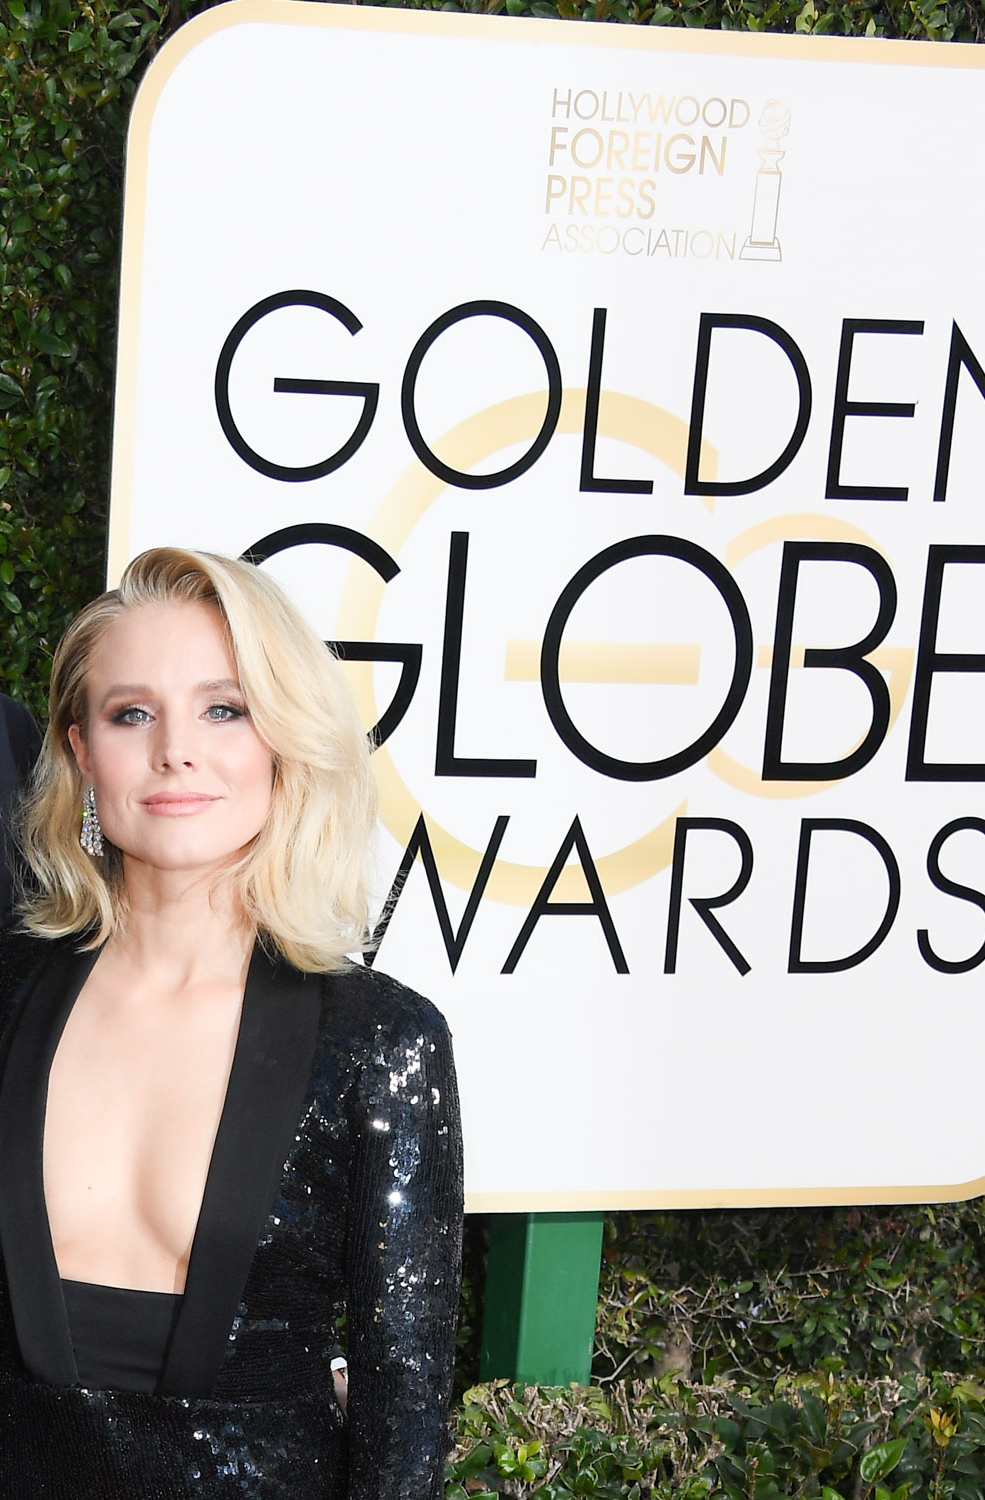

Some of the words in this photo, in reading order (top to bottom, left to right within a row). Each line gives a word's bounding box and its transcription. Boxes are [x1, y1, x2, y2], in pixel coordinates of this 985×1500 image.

[552, 88, 750, 128] HOLLYWOOD
[549, 126, 727, 176] FOREIGN
[545, 174, 657, 220] PRESS
[541, 223, 736, 260] ASSOCIATION
